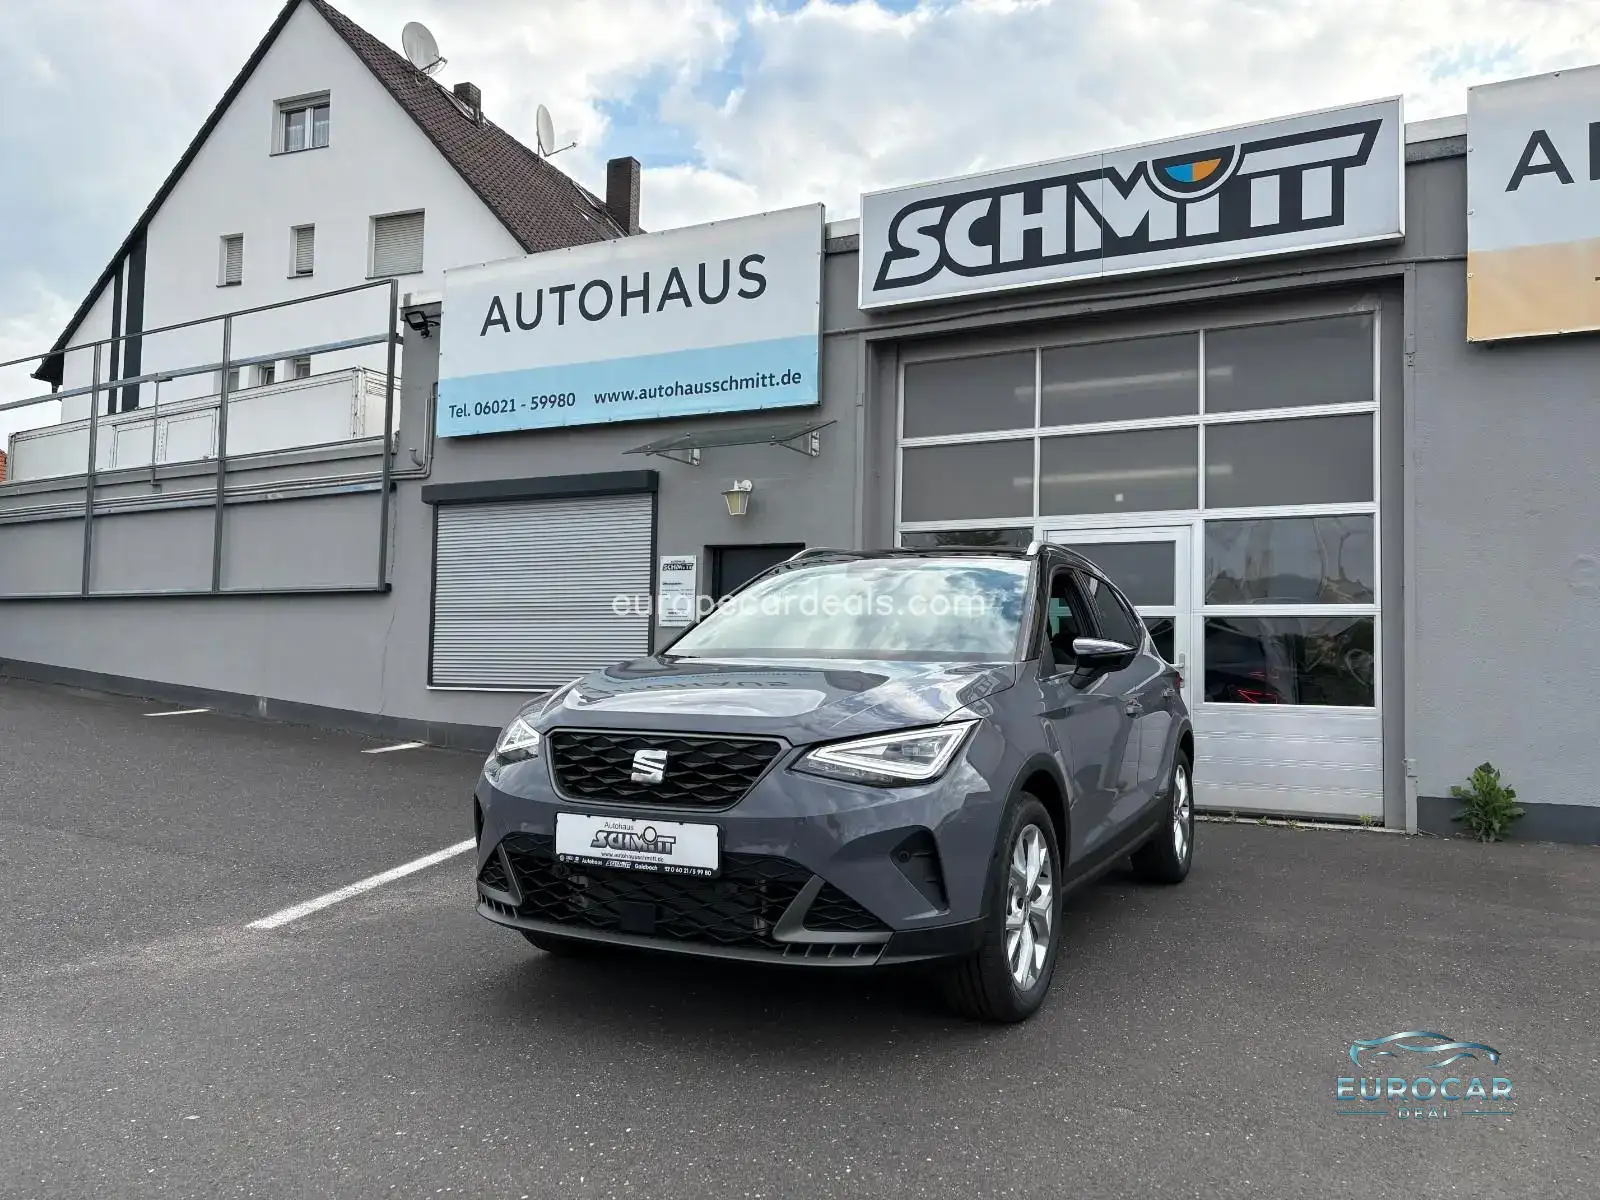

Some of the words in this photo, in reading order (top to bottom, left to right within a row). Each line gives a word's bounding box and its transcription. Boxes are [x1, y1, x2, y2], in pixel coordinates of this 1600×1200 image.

[872, 118, 1384, 292] SCHMITT
[479, 253, 768, 337] AUTOHAUS
[448, 404, 471, 419] Tel.
[474, 398, 516, 417] 06021
[530, 392, 576, 411] 59980
[593, 368, 802, 405] www.autohausschmitt.de
[603, 821, 635, 831] Autohaus
